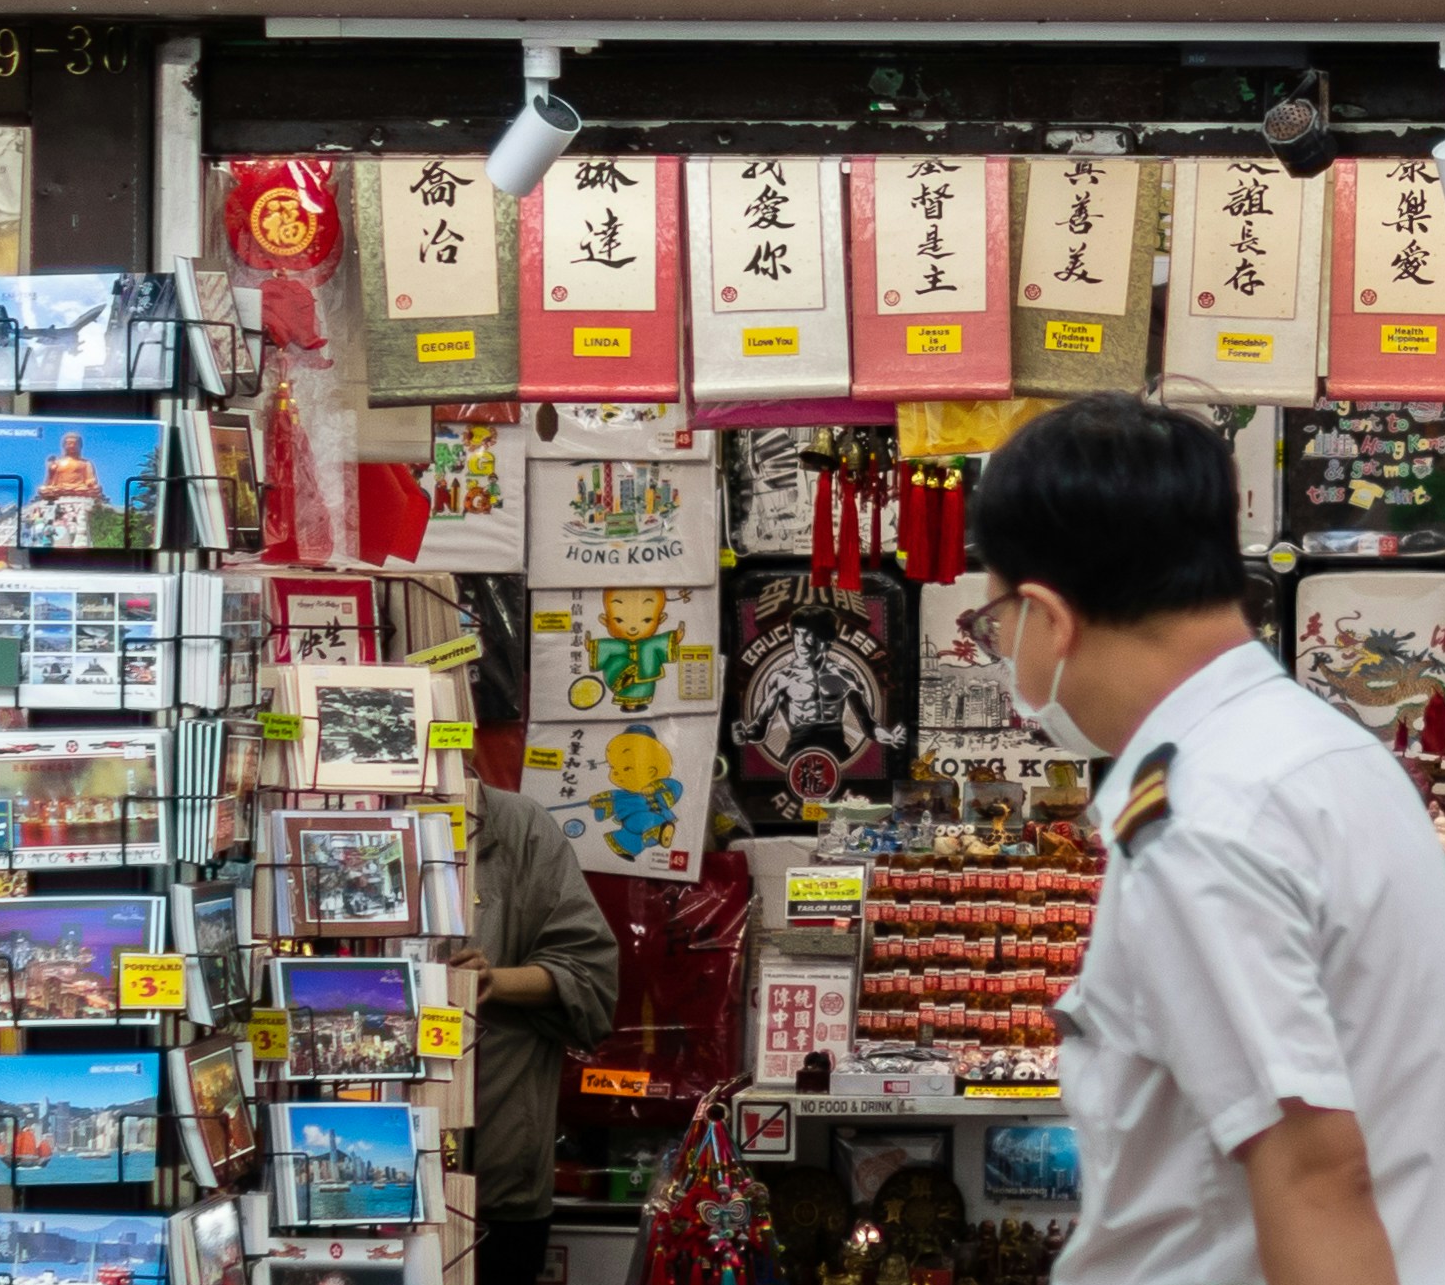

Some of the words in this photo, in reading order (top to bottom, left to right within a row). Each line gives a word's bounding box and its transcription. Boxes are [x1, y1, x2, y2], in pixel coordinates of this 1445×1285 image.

[1222, 162, 1280, 296] 誼長存
[918, 328, 951, 337] Jesus
[1061, 324, 1087, 334] Truth
[1394, 327, 1424, 336] Health
[752, 338, 774, 347] Love
[774, 337, 794, 347] You
[929, 337, 939, 345] is
[1051, 332, 1095, 343] Kindness
[1387, 335, 1430, 344] Happiness
[421, 340, 472, 353] GEORGE
[583, 338, 620, 348] LINDA
[1055, 340, 1090, 351] Beauty
[1222, 337, 1268, 349] Friendship
[1397, 344, 1419, 352] Love
[921, 344, 947, 353] Lord
[1227, 348, 1261, 359] Forever
[1361, 434, 1405, 459] Hong
[1306, 485, 1346, 504] this
[566, 545, 620, 565] HONG
[627, 540, 683, 564] KONG
[740, 621, 793, 667] BRUC
[838, 623, 878, 656] LEE
[828, 904, 853, 912] MADE
[123, 963, 183, 972] POSTCARD
[422, 1013, 462, 1023] POSTCARD
[801, 1098, 815, 1113] NO
[818, 1098, 848, 1113] FOOD
[850, 1098, 858, 1113] &
[861, 1098, 893, 1113] DRINK
